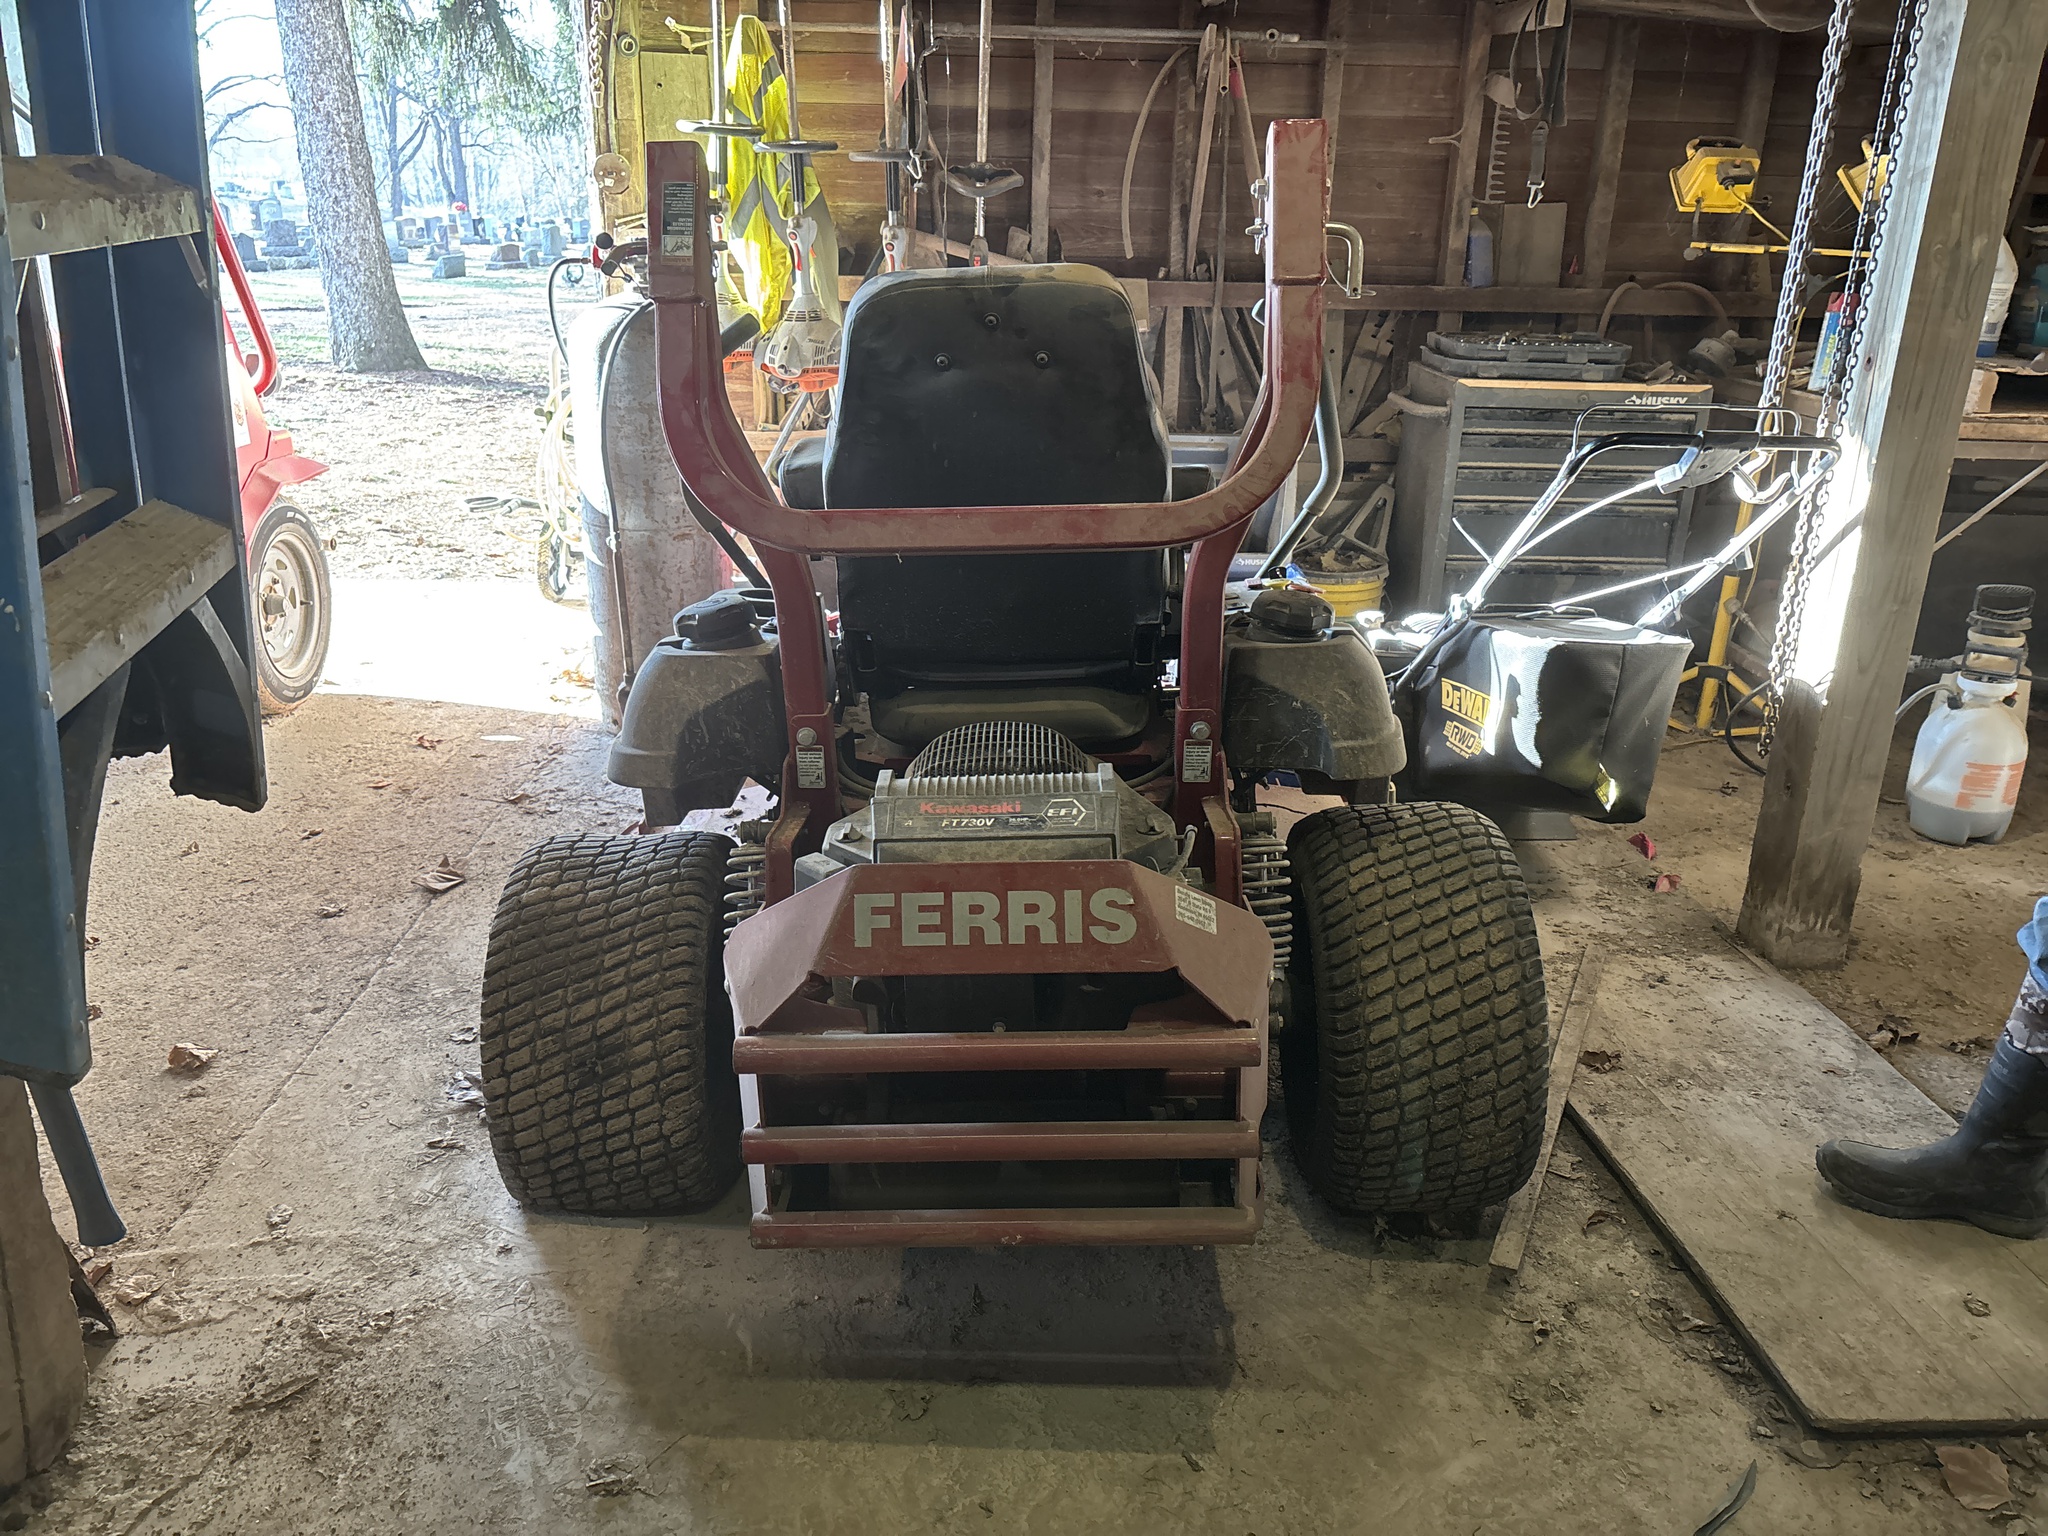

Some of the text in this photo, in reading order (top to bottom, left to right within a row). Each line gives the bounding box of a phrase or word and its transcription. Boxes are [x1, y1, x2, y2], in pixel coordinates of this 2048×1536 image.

[1641, 396, 1689, 406] HUSKY
[1450, 725, 1476, 750] RWD
[920, 801, 1021, 815] Kawasaki
[853, 887, 1138, 948] FERRIS
